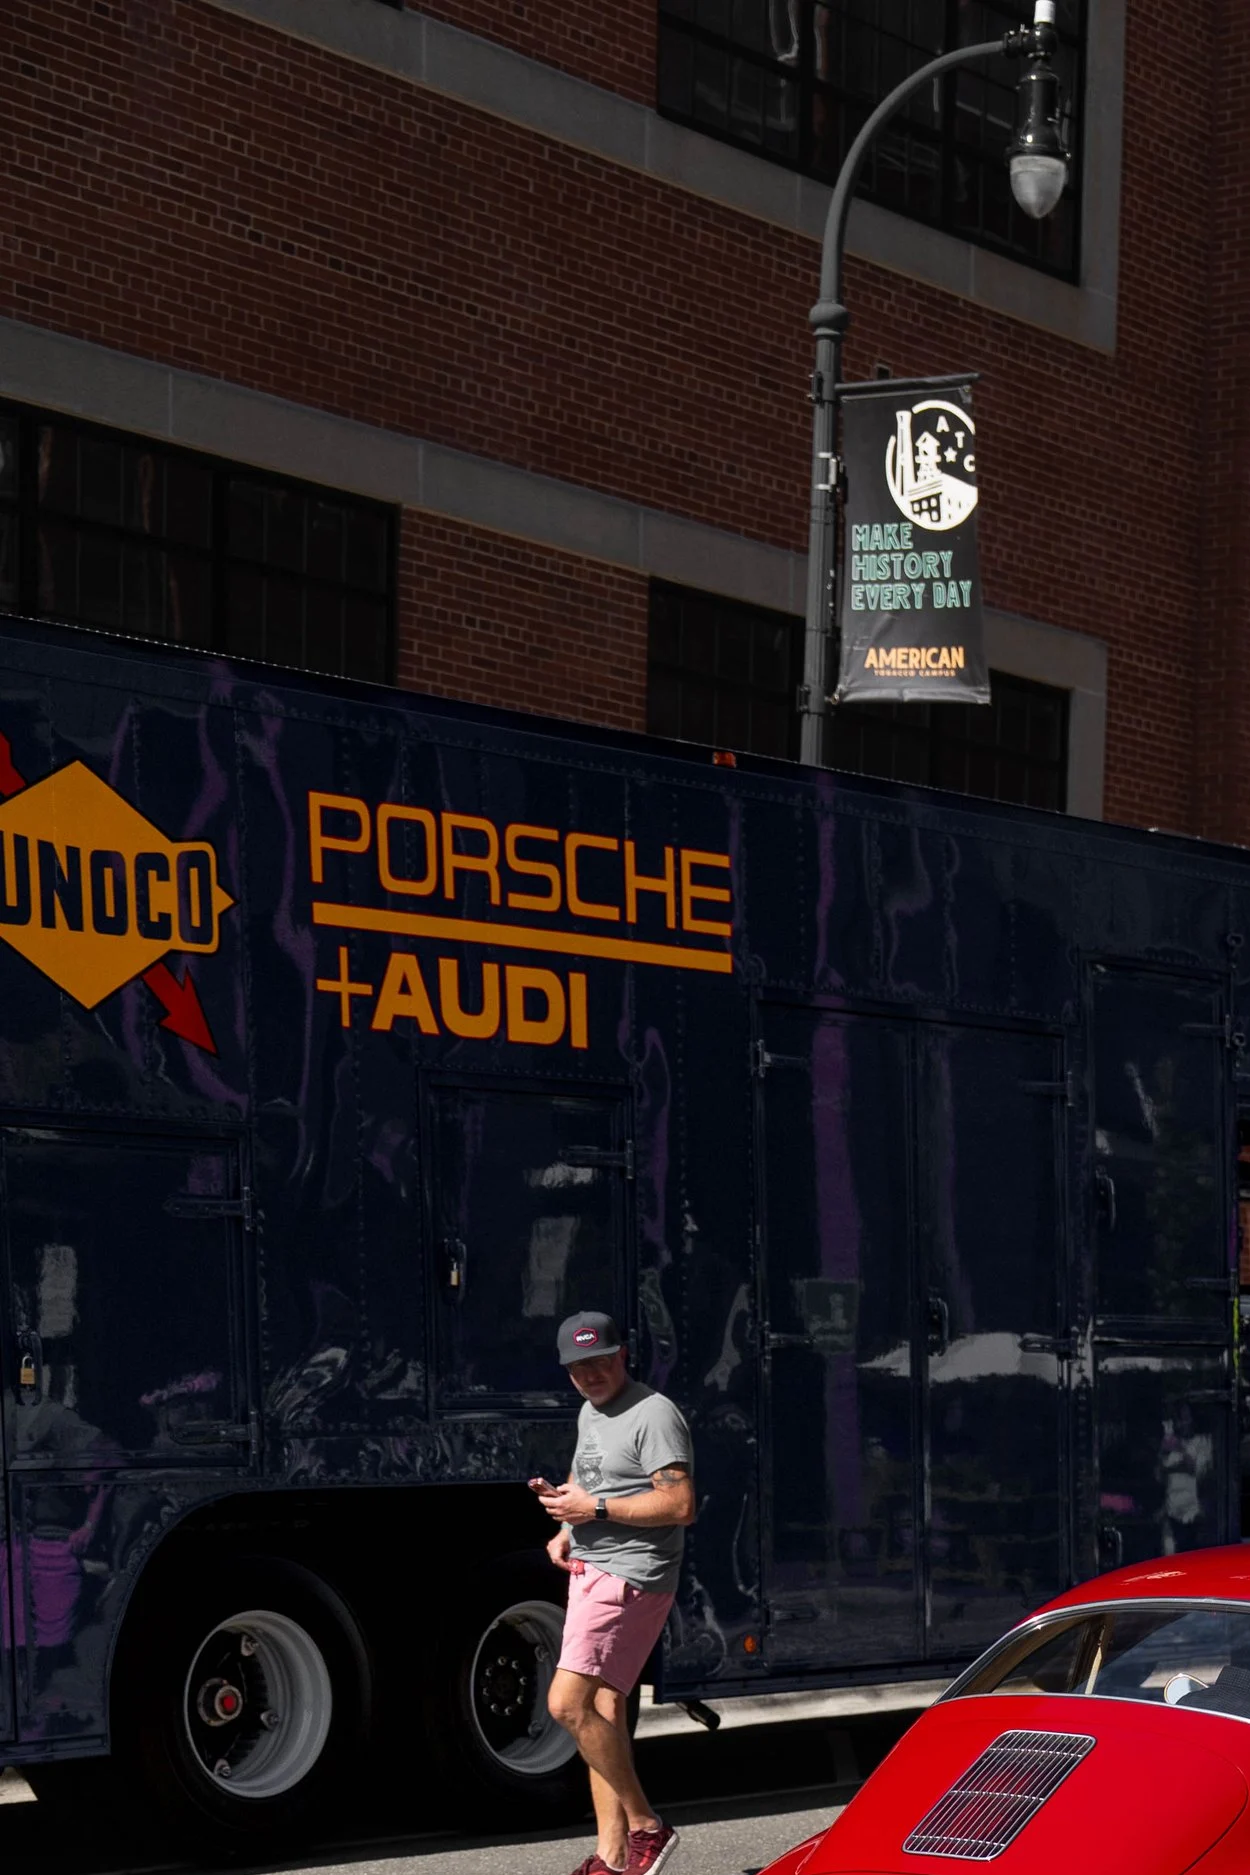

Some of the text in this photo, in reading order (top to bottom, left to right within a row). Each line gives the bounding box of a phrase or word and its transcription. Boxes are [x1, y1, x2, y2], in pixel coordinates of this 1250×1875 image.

[851, 522, 914, 551] MAKE
[851, 551, 953, 582] HISTORY
[851, 580, 973, 611] EVERY DAY
[864, 646, 965, 669] AMERICAN
[873, 669, 956, 677] TOBACCO CAMPUS
[308, 790, 732, 937] PORSCHE
[0, 829, 213, 945] UNOCO
[316, 946, 588, 1049] +AUDI
